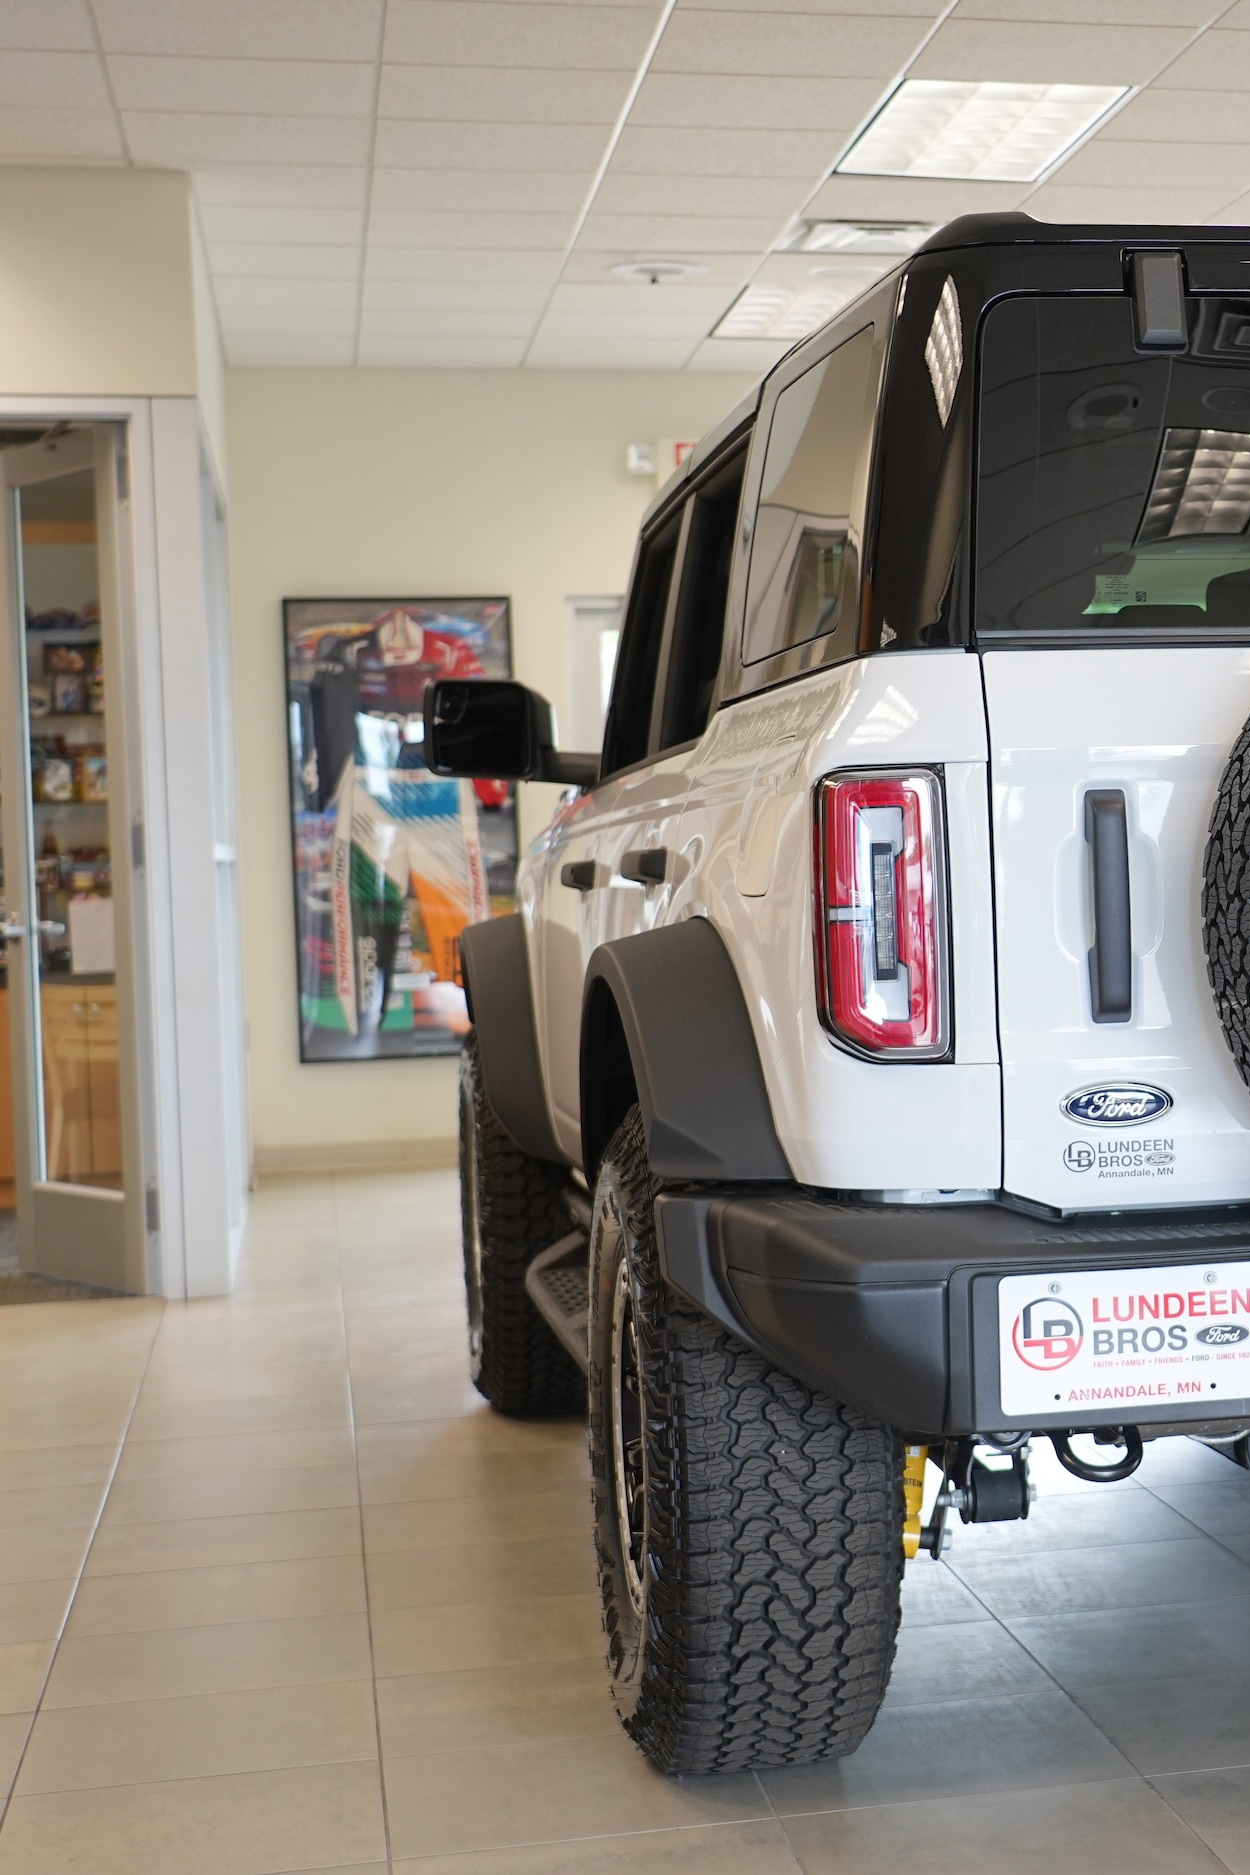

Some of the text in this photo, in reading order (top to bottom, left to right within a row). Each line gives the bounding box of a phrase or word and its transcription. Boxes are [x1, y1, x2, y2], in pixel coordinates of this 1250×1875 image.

[1087, 1092, 1147, 1118] Ford
[1098, 1139, 1174, 1153] LUNDEEN
[1098, 1154, 1143, 1167] BROS
[1098, 1167, 1174, 1178] Annandale, MN
[1093, 1325, 1188, 1355] BROS
[1093, 1360, 1113, 1368] FAITH
[1121, 1358, 1146, 1367] FAMILY
[1154, 1356, 1183, 1364] FRIENDS
[1192, 1354, 1210, 1362] FORD
[1067, 1381, 1202, 1402] ANNANDALE, MN
